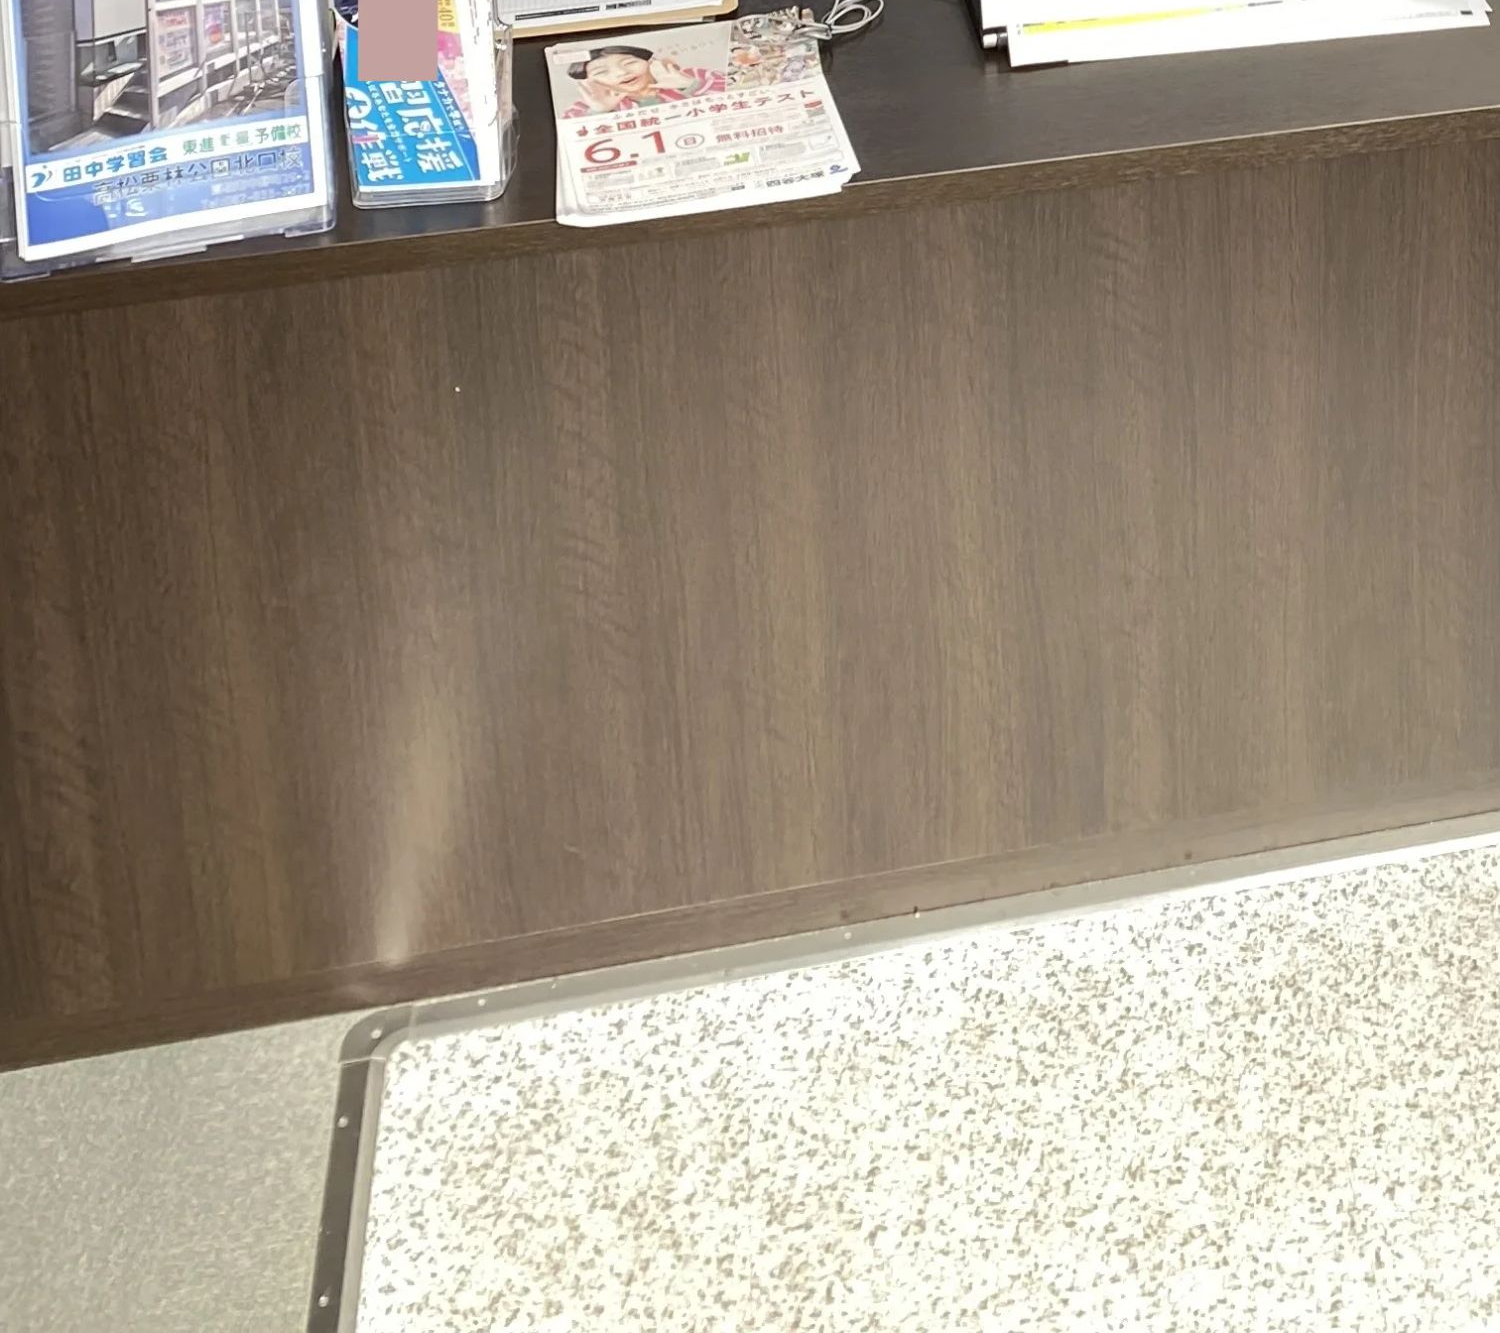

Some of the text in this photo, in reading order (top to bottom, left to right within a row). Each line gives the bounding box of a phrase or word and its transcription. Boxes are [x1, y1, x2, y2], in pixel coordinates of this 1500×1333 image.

[594, 90, 816, 133] 全国統一小学生テスト
[63, 146, 168, 183] 田中学習会
[585, 131, 666, 164] 6.1
